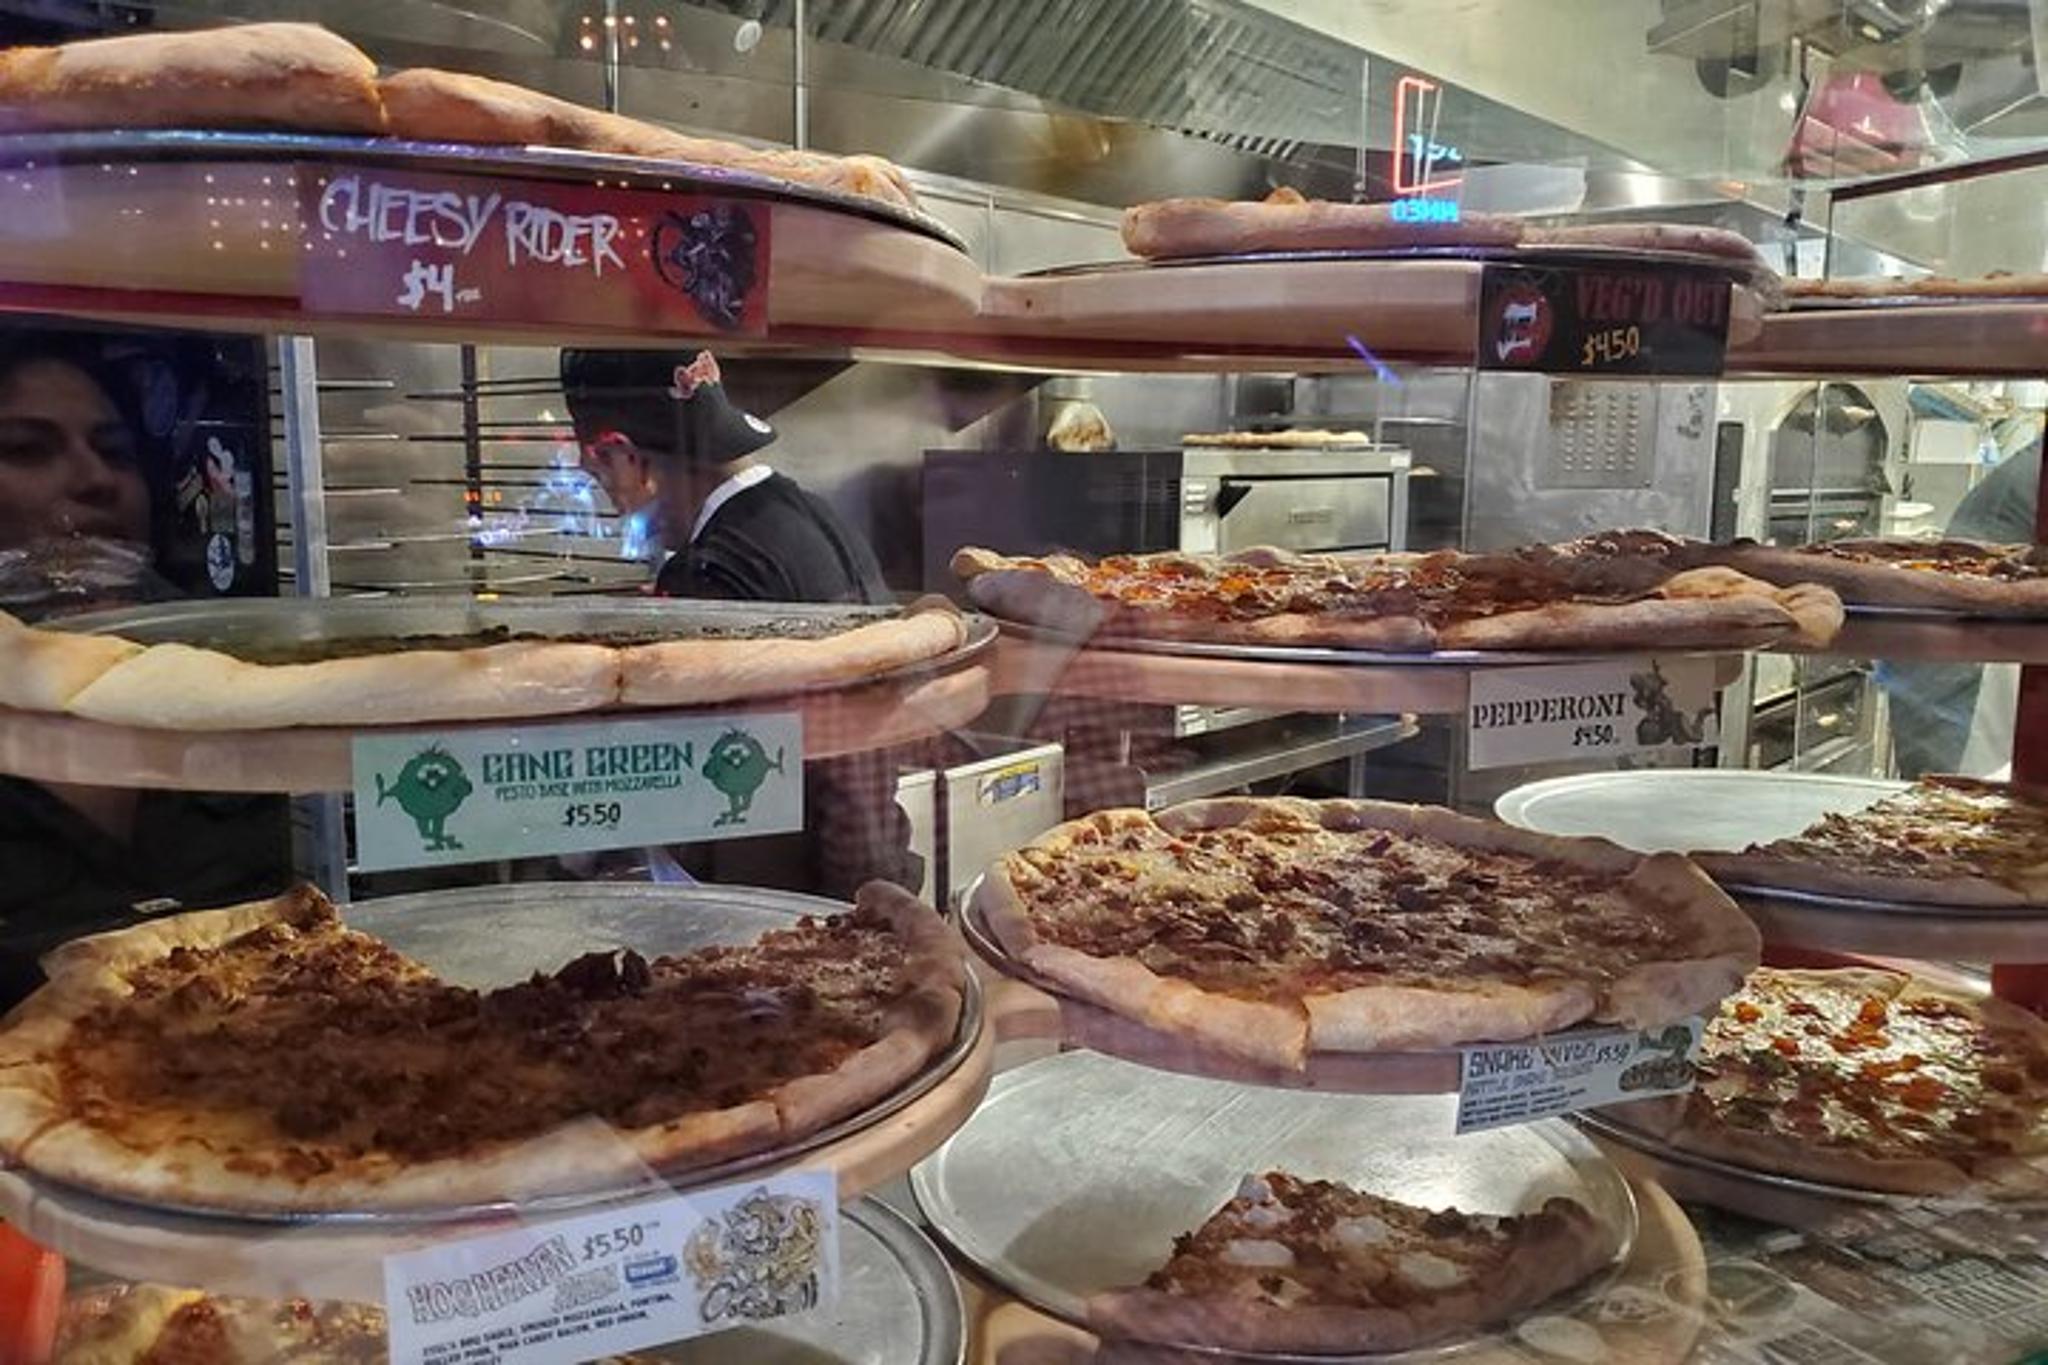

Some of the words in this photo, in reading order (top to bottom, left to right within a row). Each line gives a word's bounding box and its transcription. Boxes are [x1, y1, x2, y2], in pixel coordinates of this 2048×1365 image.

[319, 175, 501, 255] CHEESY
[505, 200, 625, 277] RIDER
[1577, 275, 1663, 321] VEG'D
[1672, 278, 1727, 324] OUT
[1472, 693, 1625, 728] PEPPERONI
[482, 750, 573, 784] GANG
[585, 742, 693, 778] GREEN
[495, 784, 536, 801] PESTO
[539, 782, 569, 798] BASE
[604, 775, 682, 793] MOZZARELLA
